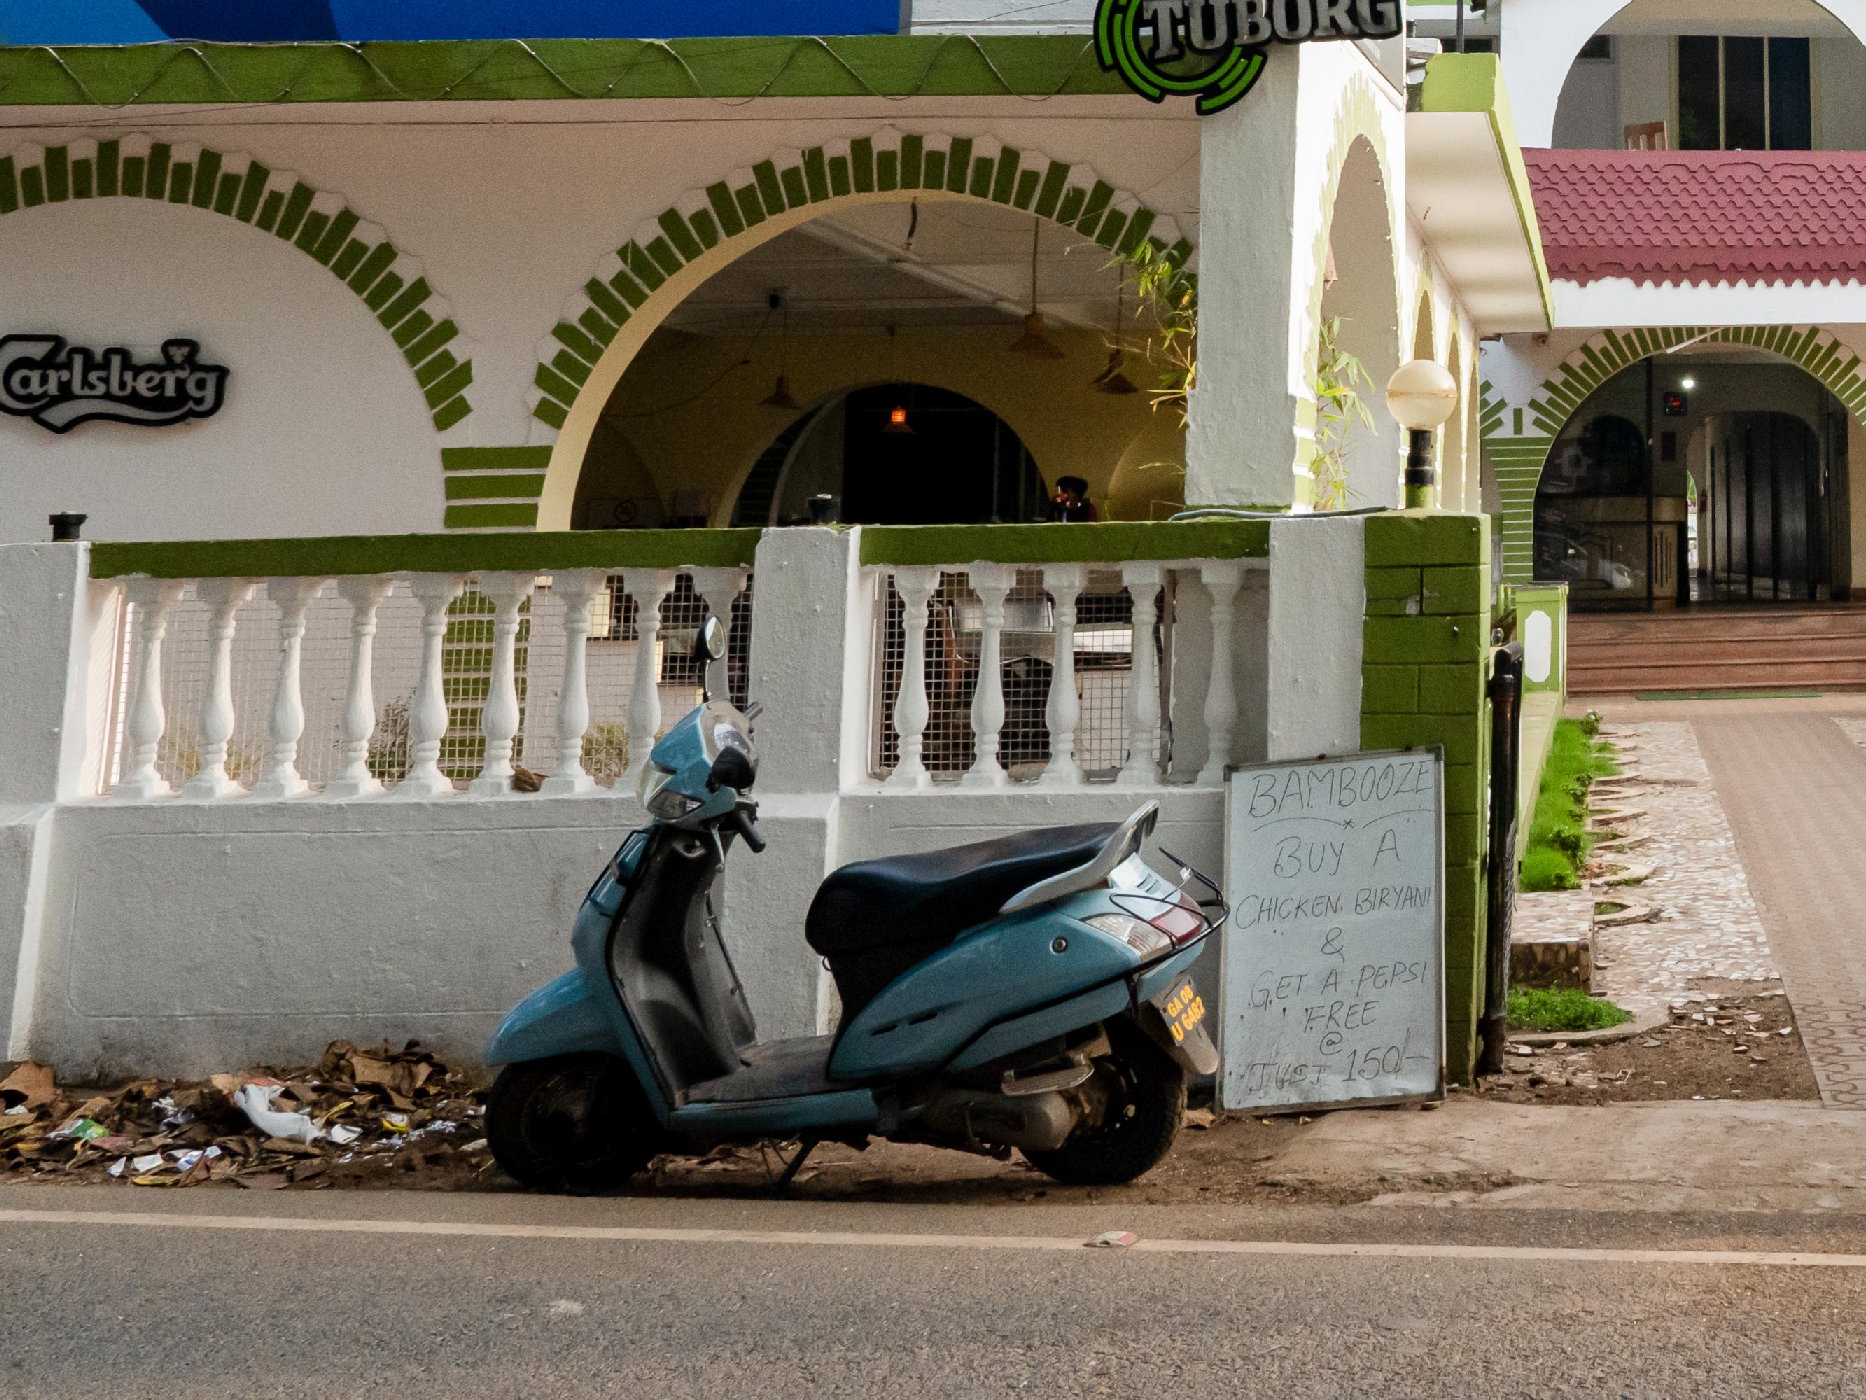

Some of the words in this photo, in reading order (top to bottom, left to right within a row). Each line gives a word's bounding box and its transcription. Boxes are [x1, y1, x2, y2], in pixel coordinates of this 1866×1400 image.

[0, 338, 222, 414] Carlsberg
[1248, 759, 1433, 818] BAMBOOZE
[1274, 836, 1345, 879] BUY
[1373, 828, 1400, 867] A
[1354, 886, 1432, 916] BIRYANI
[1320, 926, 1345, 963] &
[1250, 970, 1306, 1008] GET
[1320, 968, 1340, 995] A
[1355, 962, 1428, 998] PEPSI
[1167, 996, 1184, 1018] GA
[1304, 1000, 1380, 1033] FREE
[1319, 1031, 1343, 1056] @
